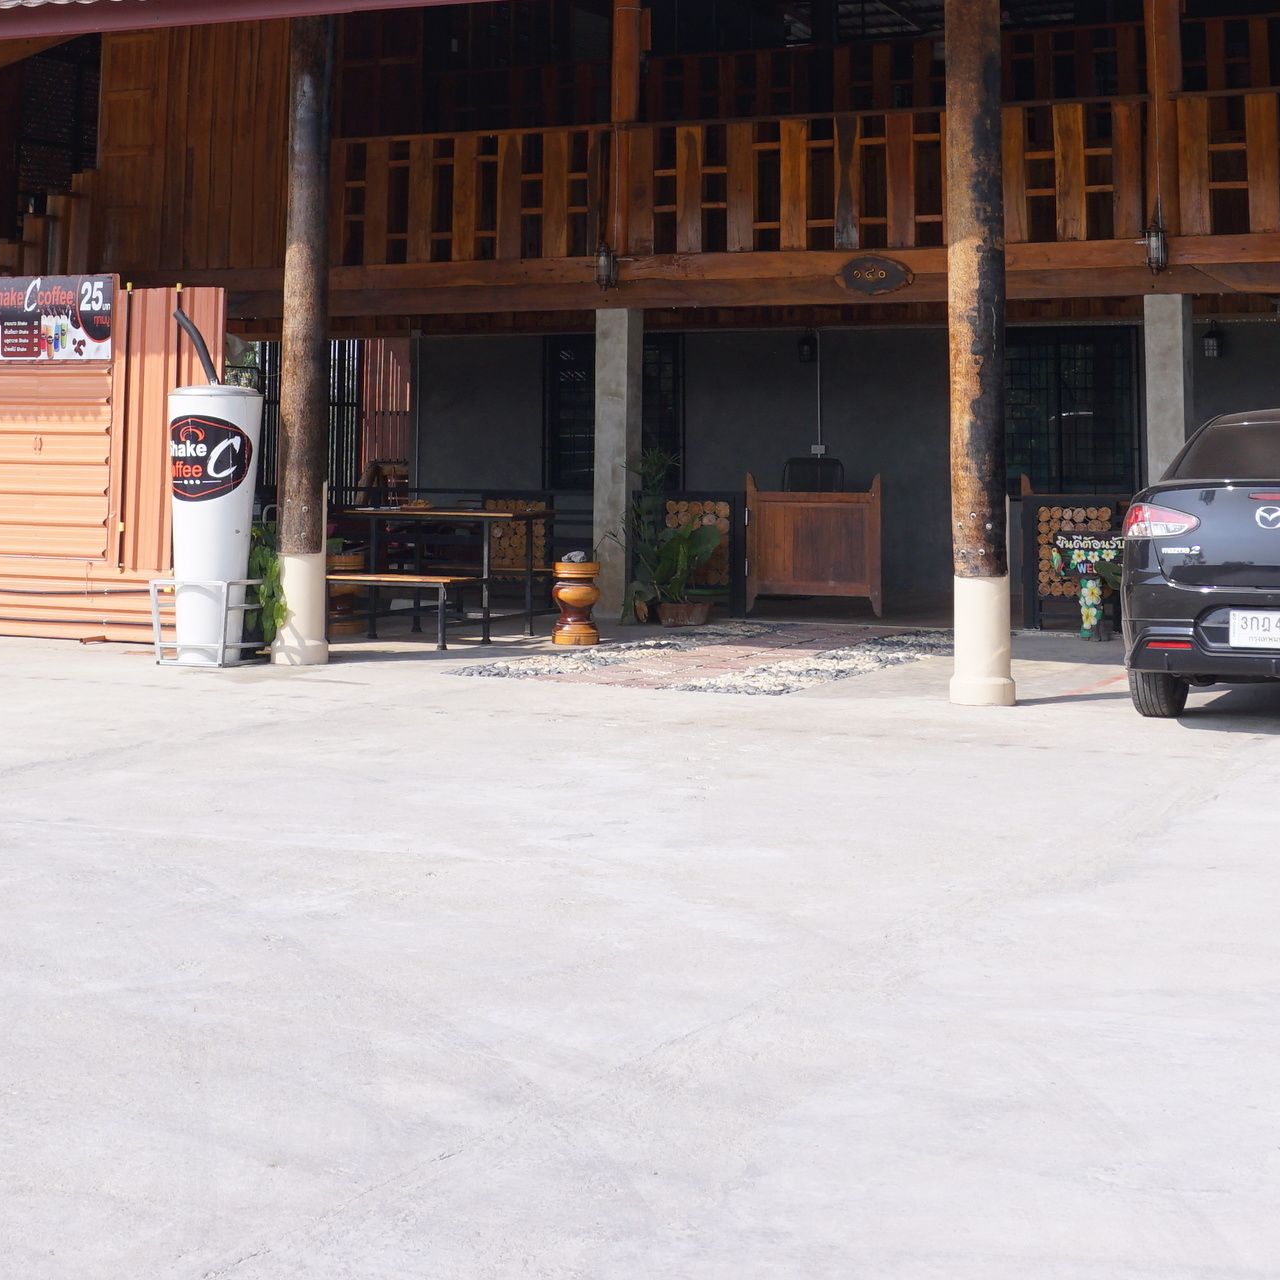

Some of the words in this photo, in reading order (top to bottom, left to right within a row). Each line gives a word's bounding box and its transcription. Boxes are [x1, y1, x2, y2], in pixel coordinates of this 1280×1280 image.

[37, 285, 74, 306] coffee
[80, 281, 104, 311] 25
[170, 440, 208, 457] hake
